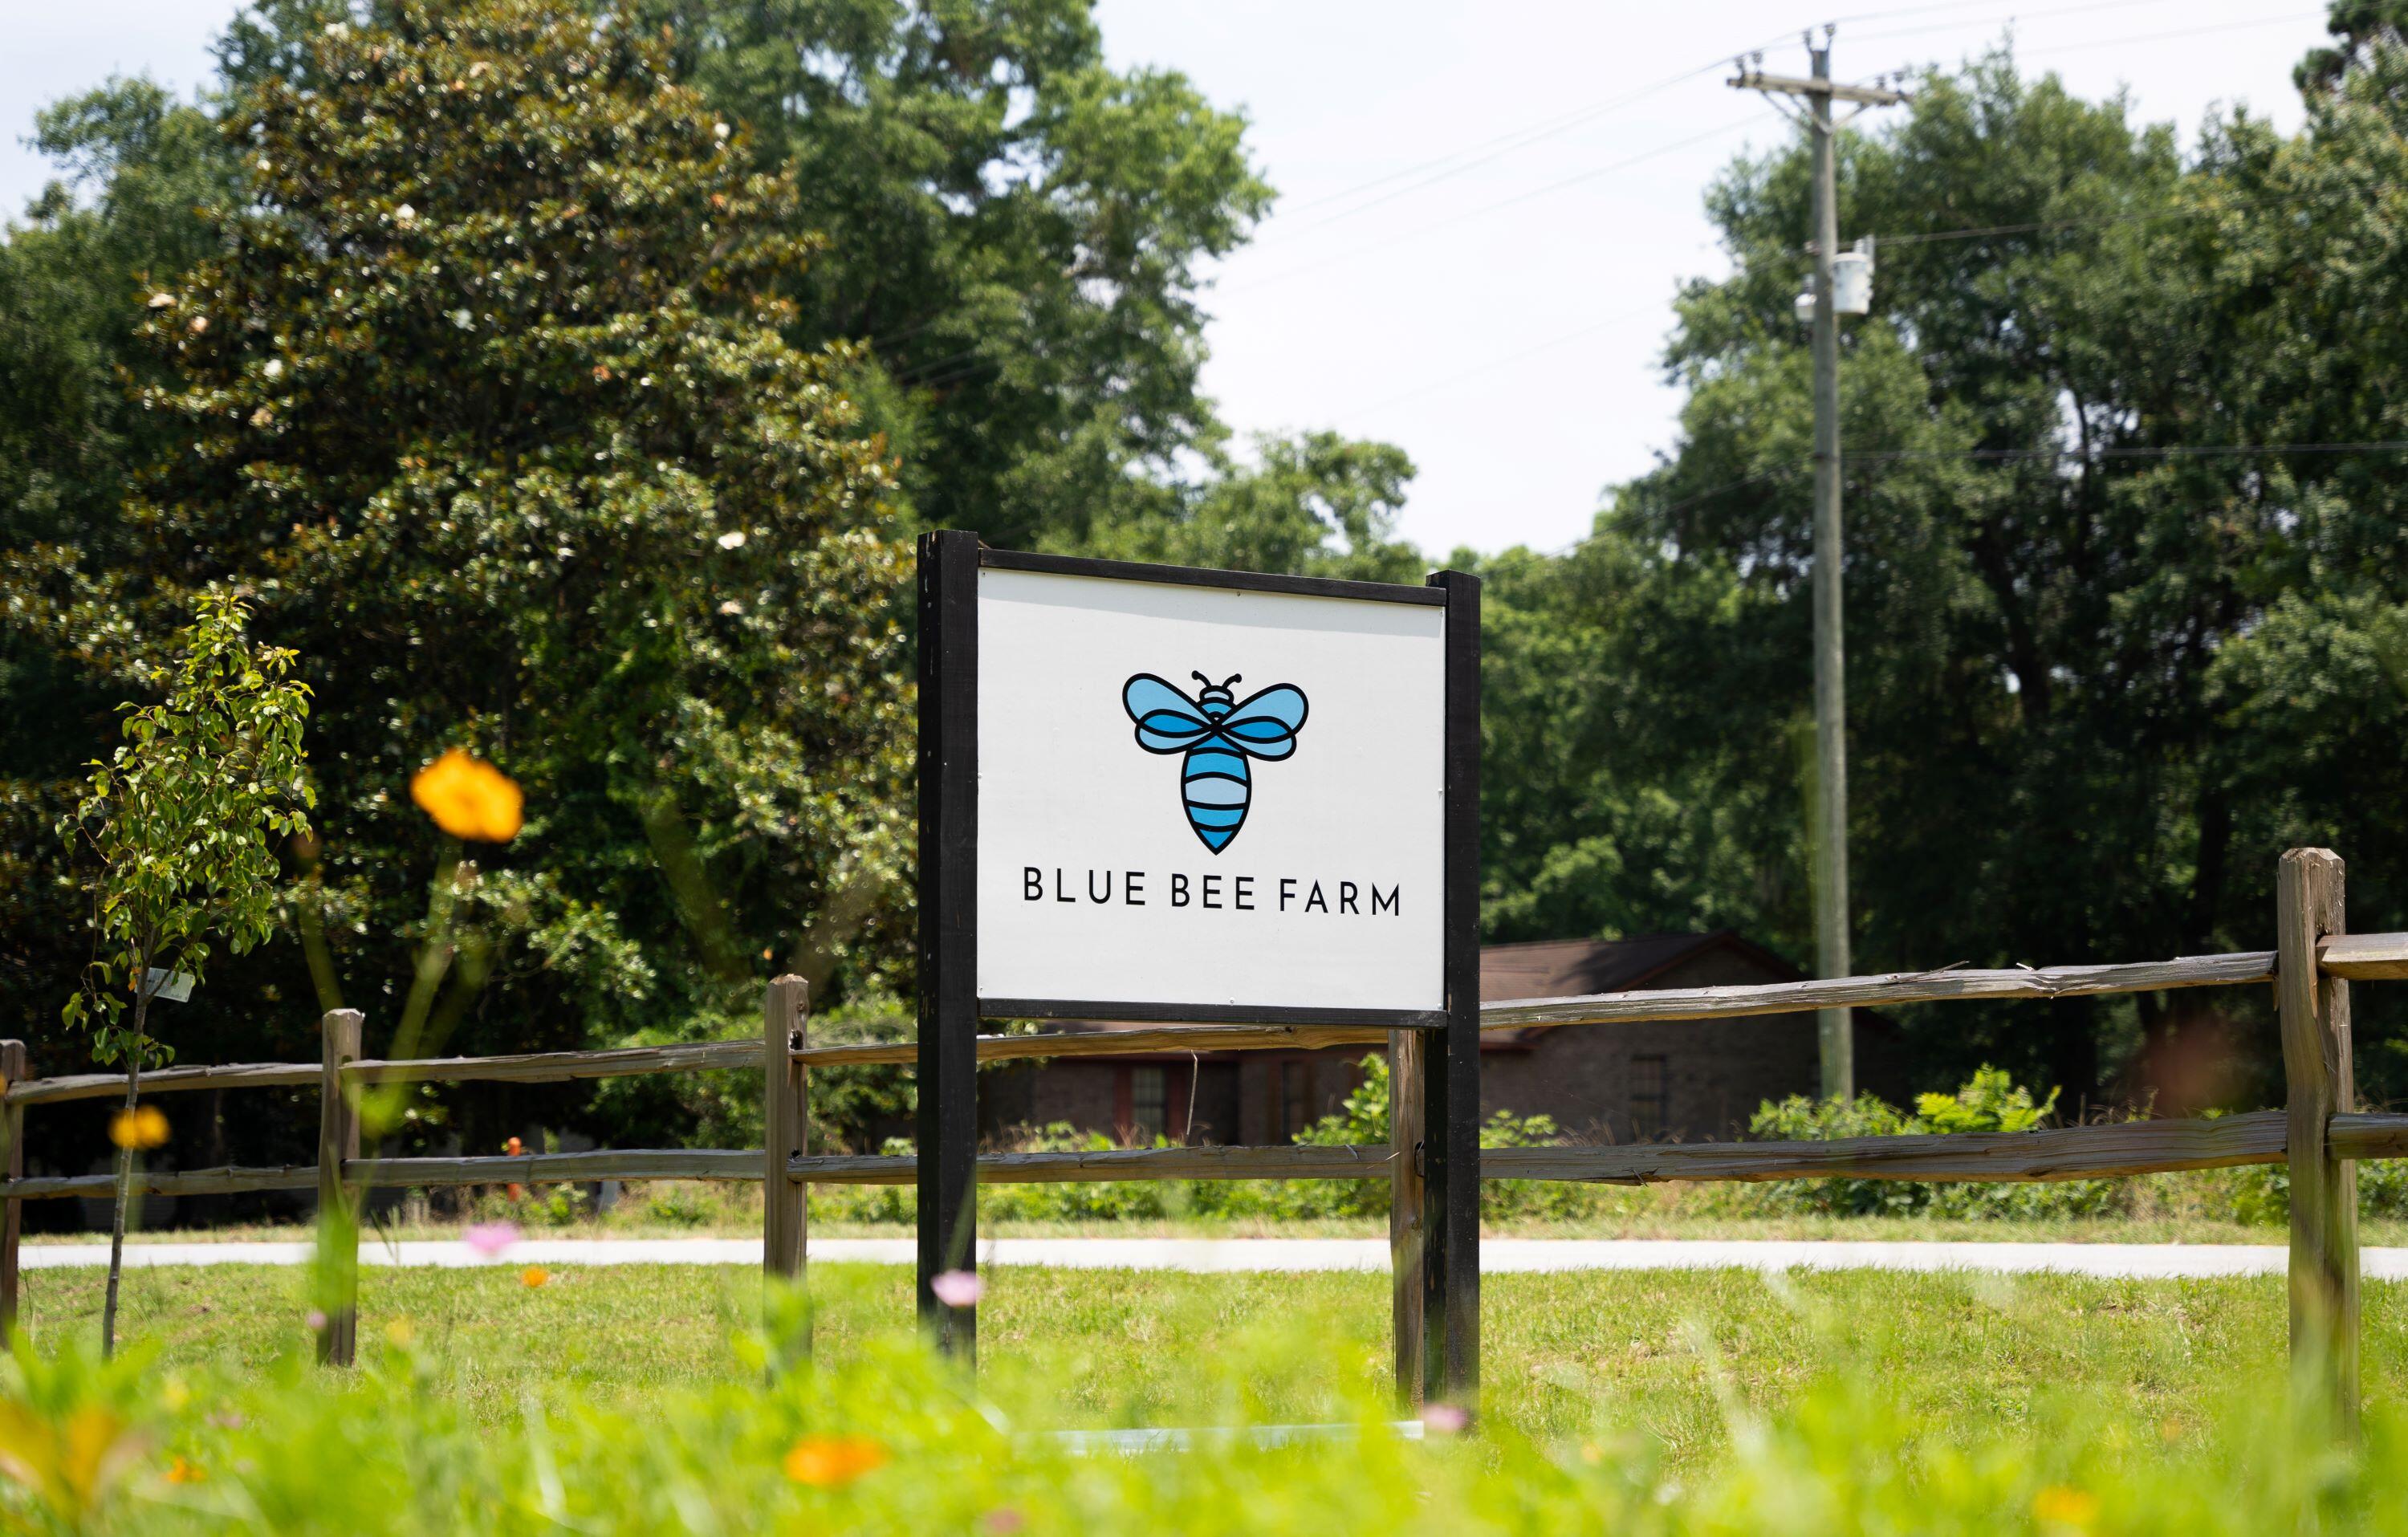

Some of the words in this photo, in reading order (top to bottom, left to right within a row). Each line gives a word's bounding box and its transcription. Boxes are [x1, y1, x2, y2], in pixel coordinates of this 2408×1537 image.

[1023, 866, 1145, 908] BLUE
[1171, 872, 1255, 911] BEE
[1279, 878, 1399, 917] FARM
